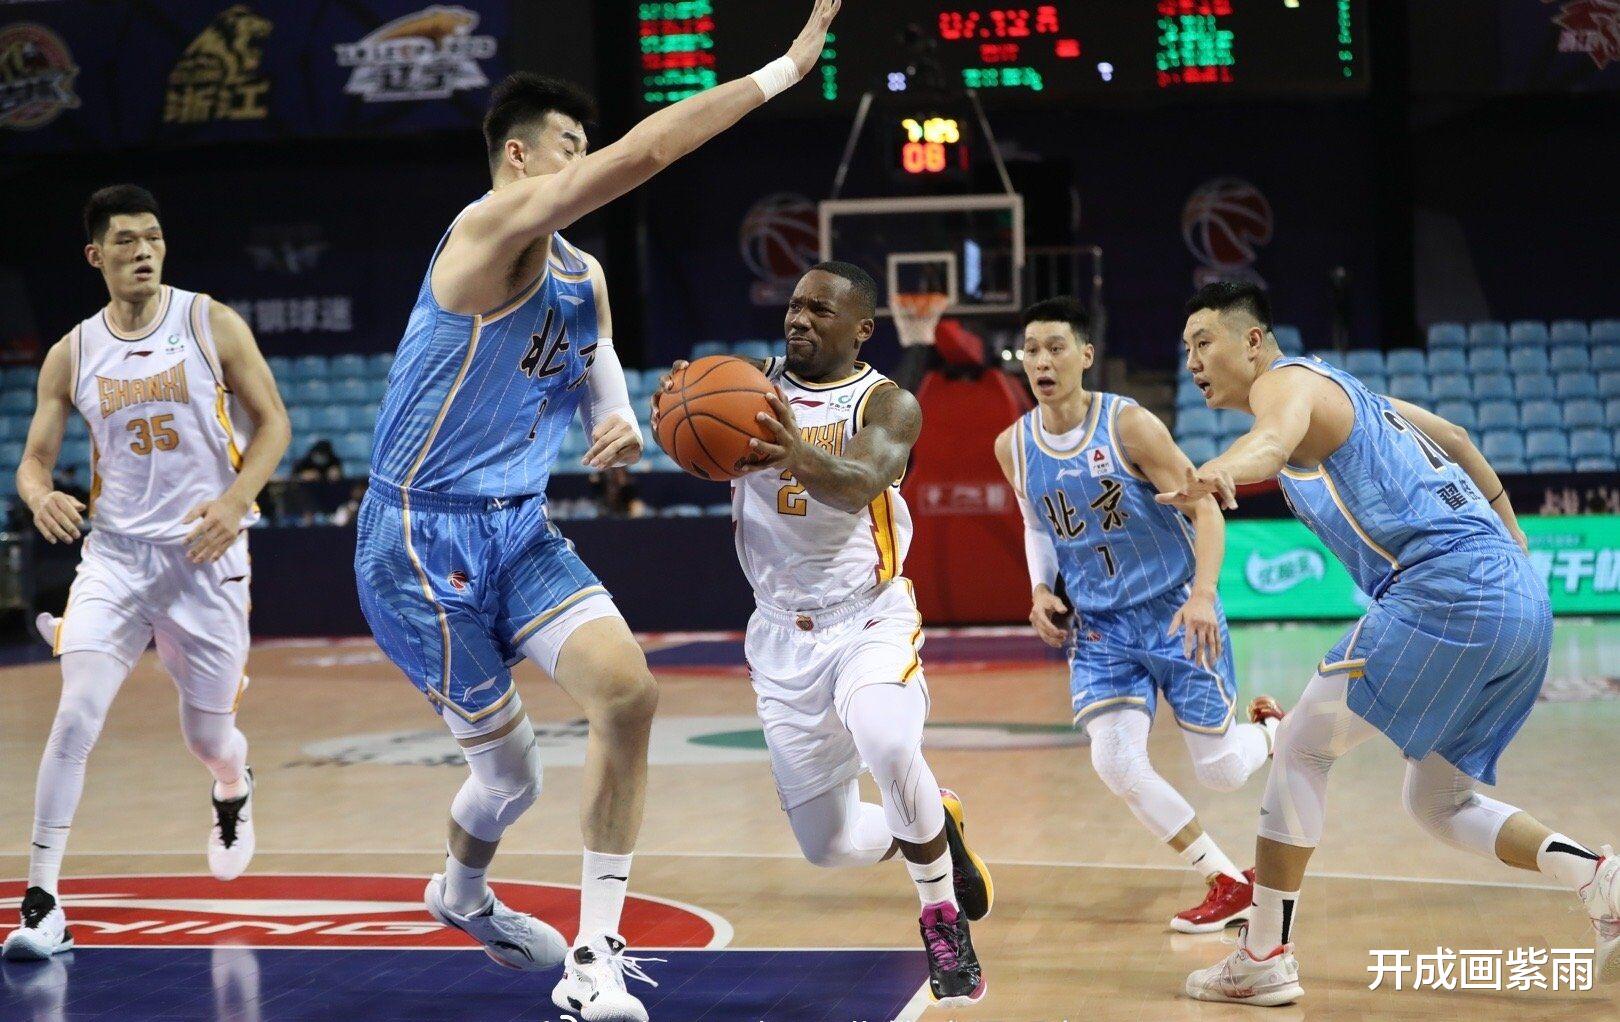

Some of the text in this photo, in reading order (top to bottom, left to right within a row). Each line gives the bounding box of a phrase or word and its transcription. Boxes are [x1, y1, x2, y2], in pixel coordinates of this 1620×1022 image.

[94, 359, 189, 419] SHANXI
[126, 413, 180, 456] 35
[777, 468, 807, 516] 2
[1044, 479, 1129, 541] 北京
